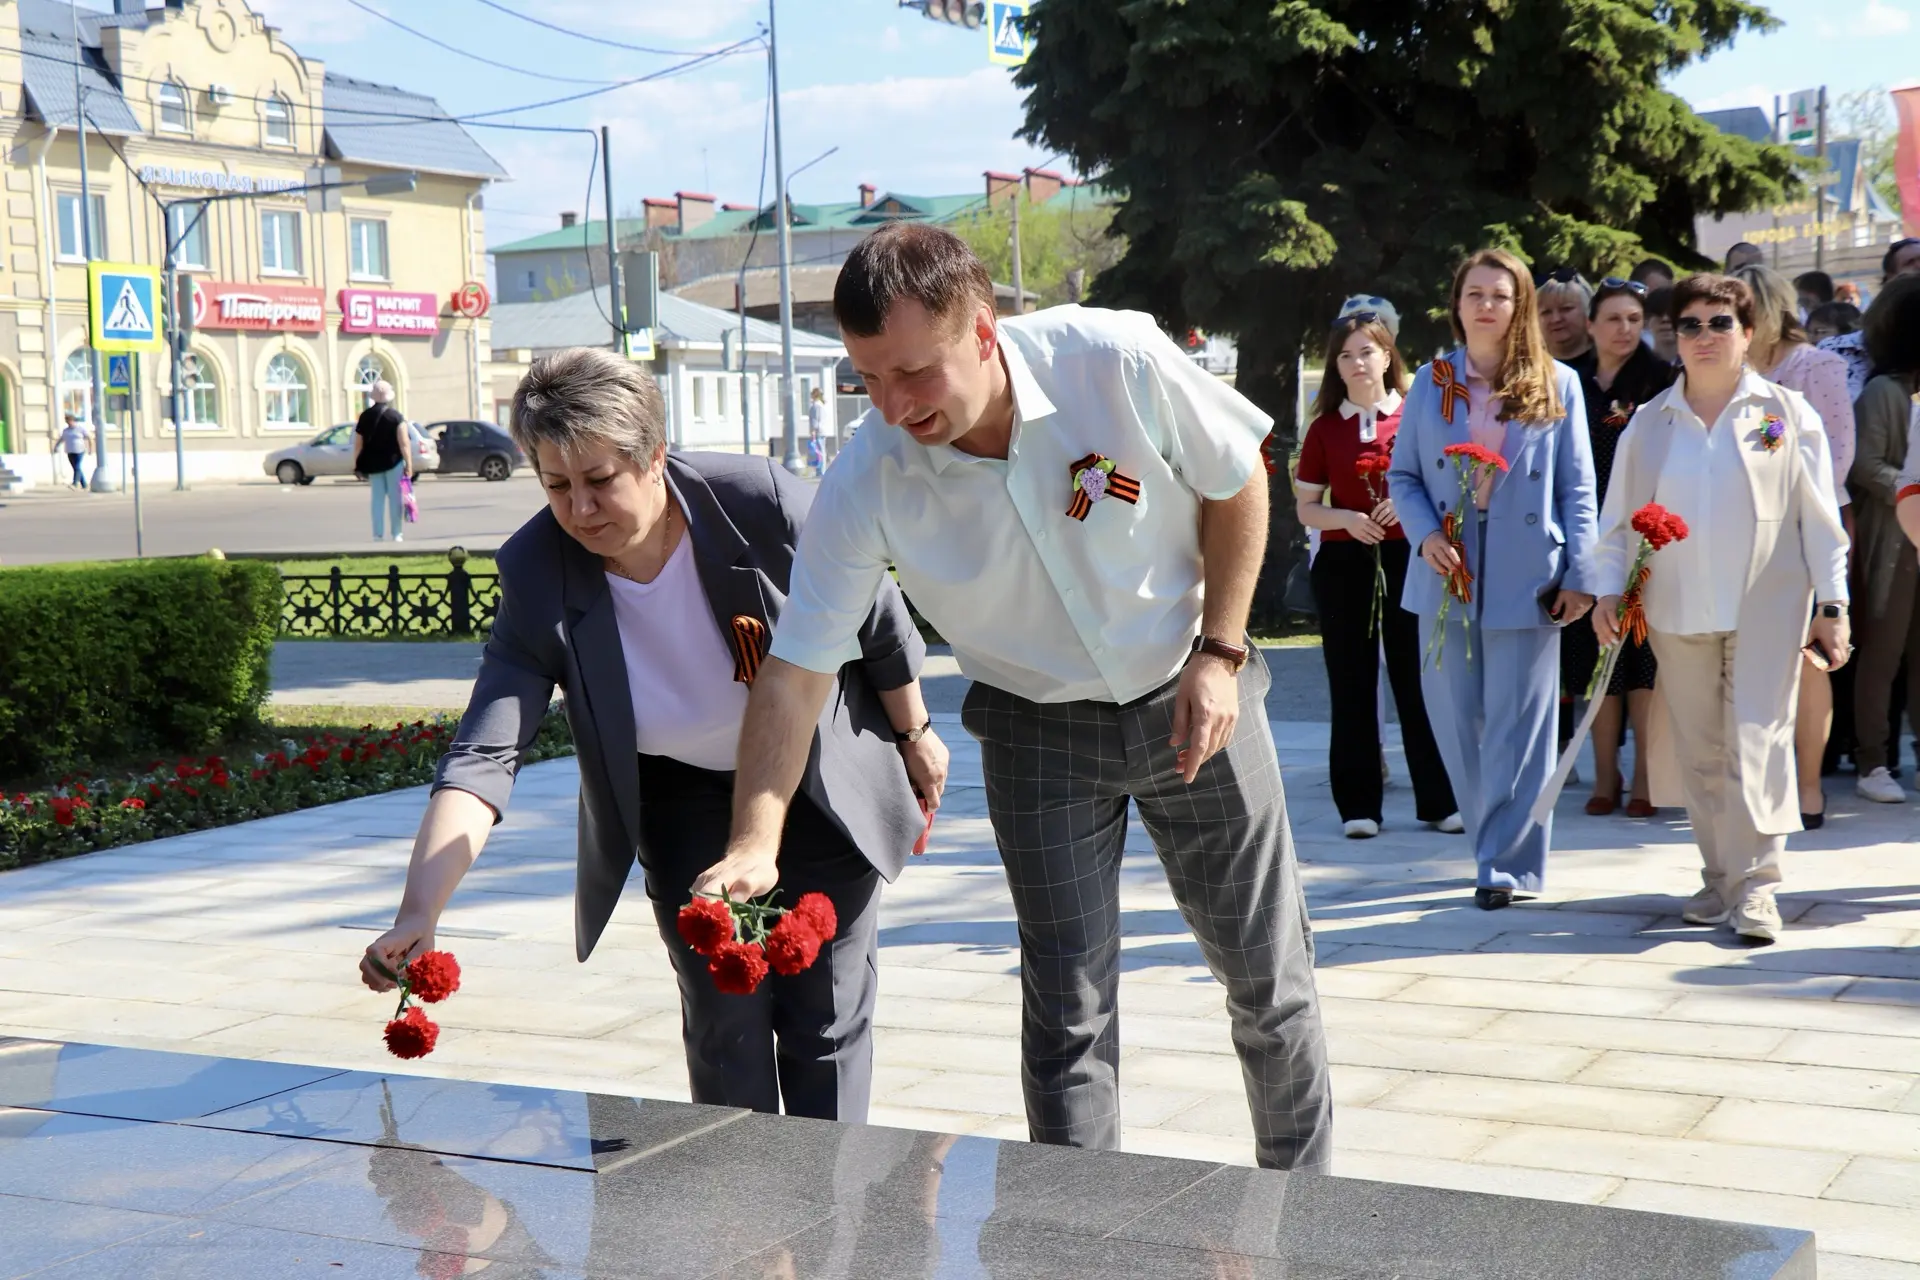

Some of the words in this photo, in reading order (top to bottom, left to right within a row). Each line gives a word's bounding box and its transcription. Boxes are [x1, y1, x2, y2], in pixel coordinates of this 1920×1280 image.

[140, 165, 252, 193] ЯЗЫКОВАЯ
[375, 296, 421, 312] МАГНИТ
[376, 313, 437, 330] КОСМЕТИК
